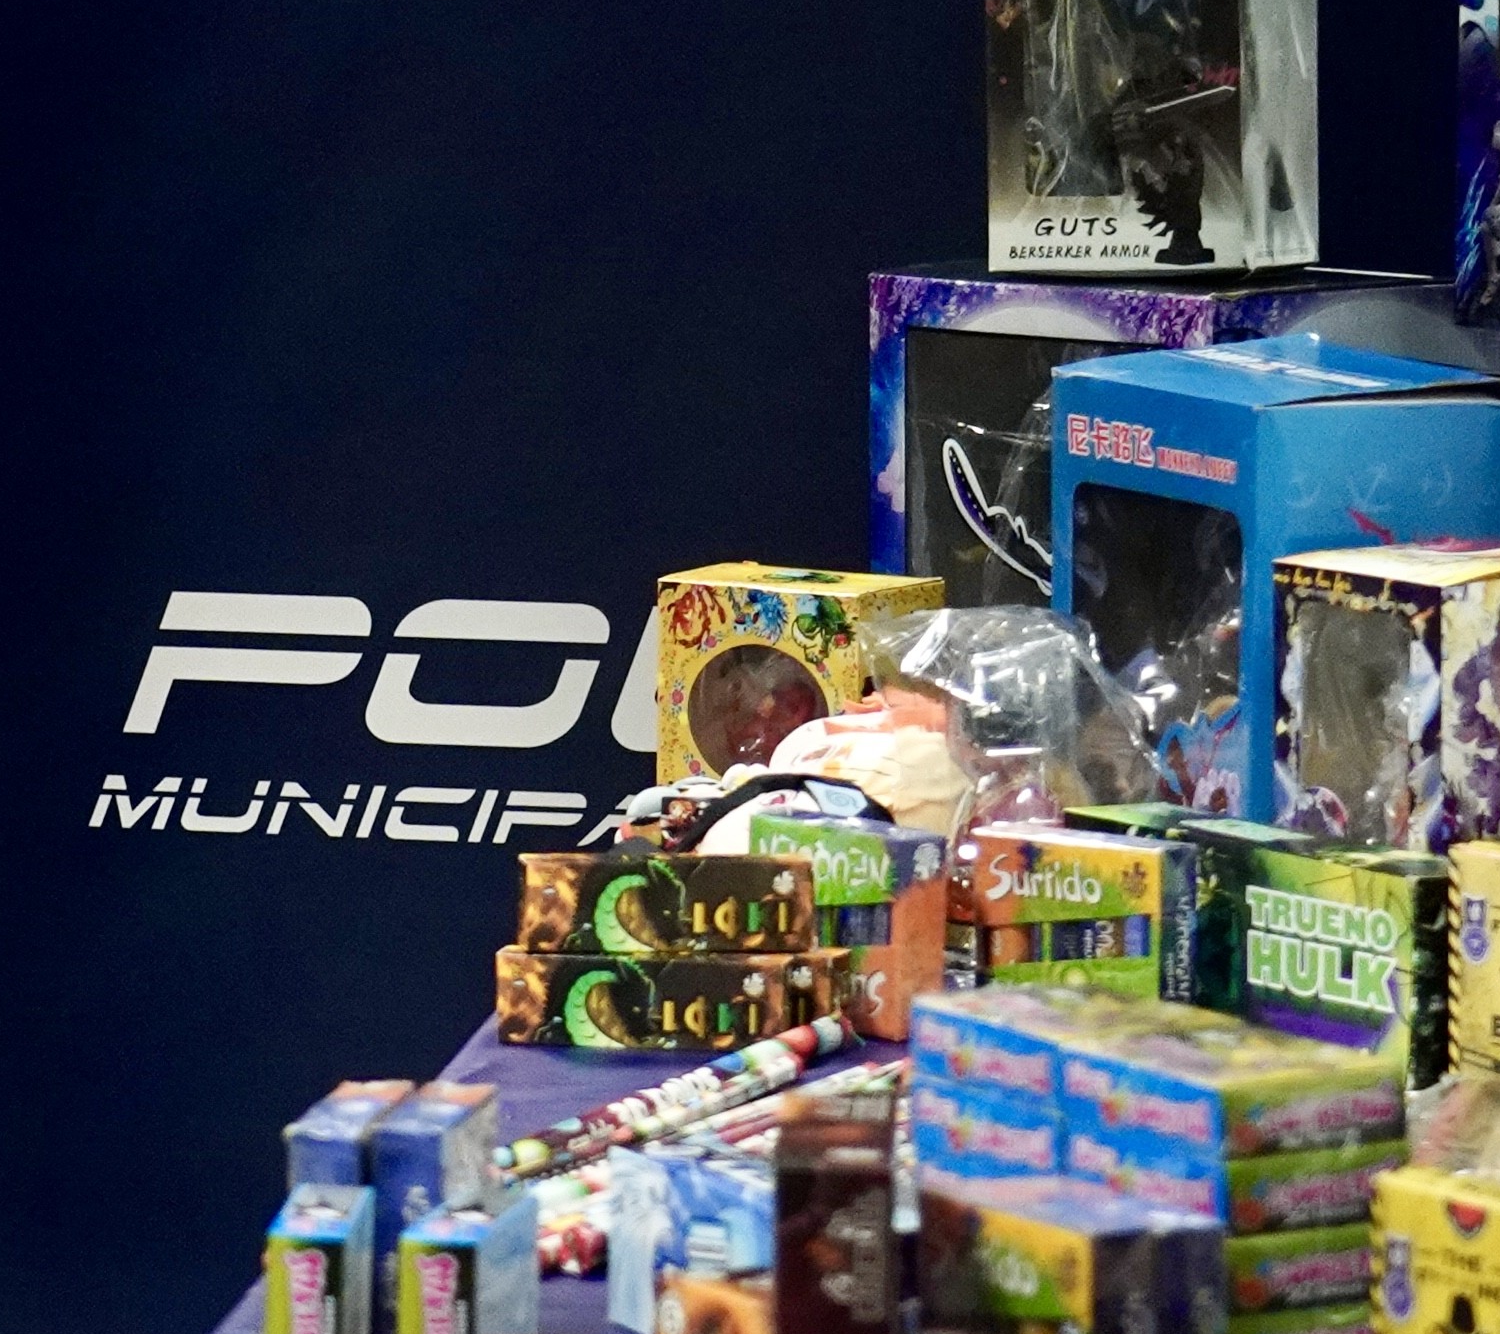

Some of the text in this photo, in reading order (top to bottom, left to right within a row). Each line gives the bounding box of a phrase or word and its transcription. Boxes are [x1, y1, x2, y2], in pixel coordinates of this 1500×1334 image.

[1008, 243, 1151, 260] BERSERKER ARMOR
[1034, 216, 1119, 238] GUTS
[985, 854, 1104, 905] Surtido
[1246, 885, 1400, 952] TRUENO
[1247, 929, 1398, 1013] HULK
